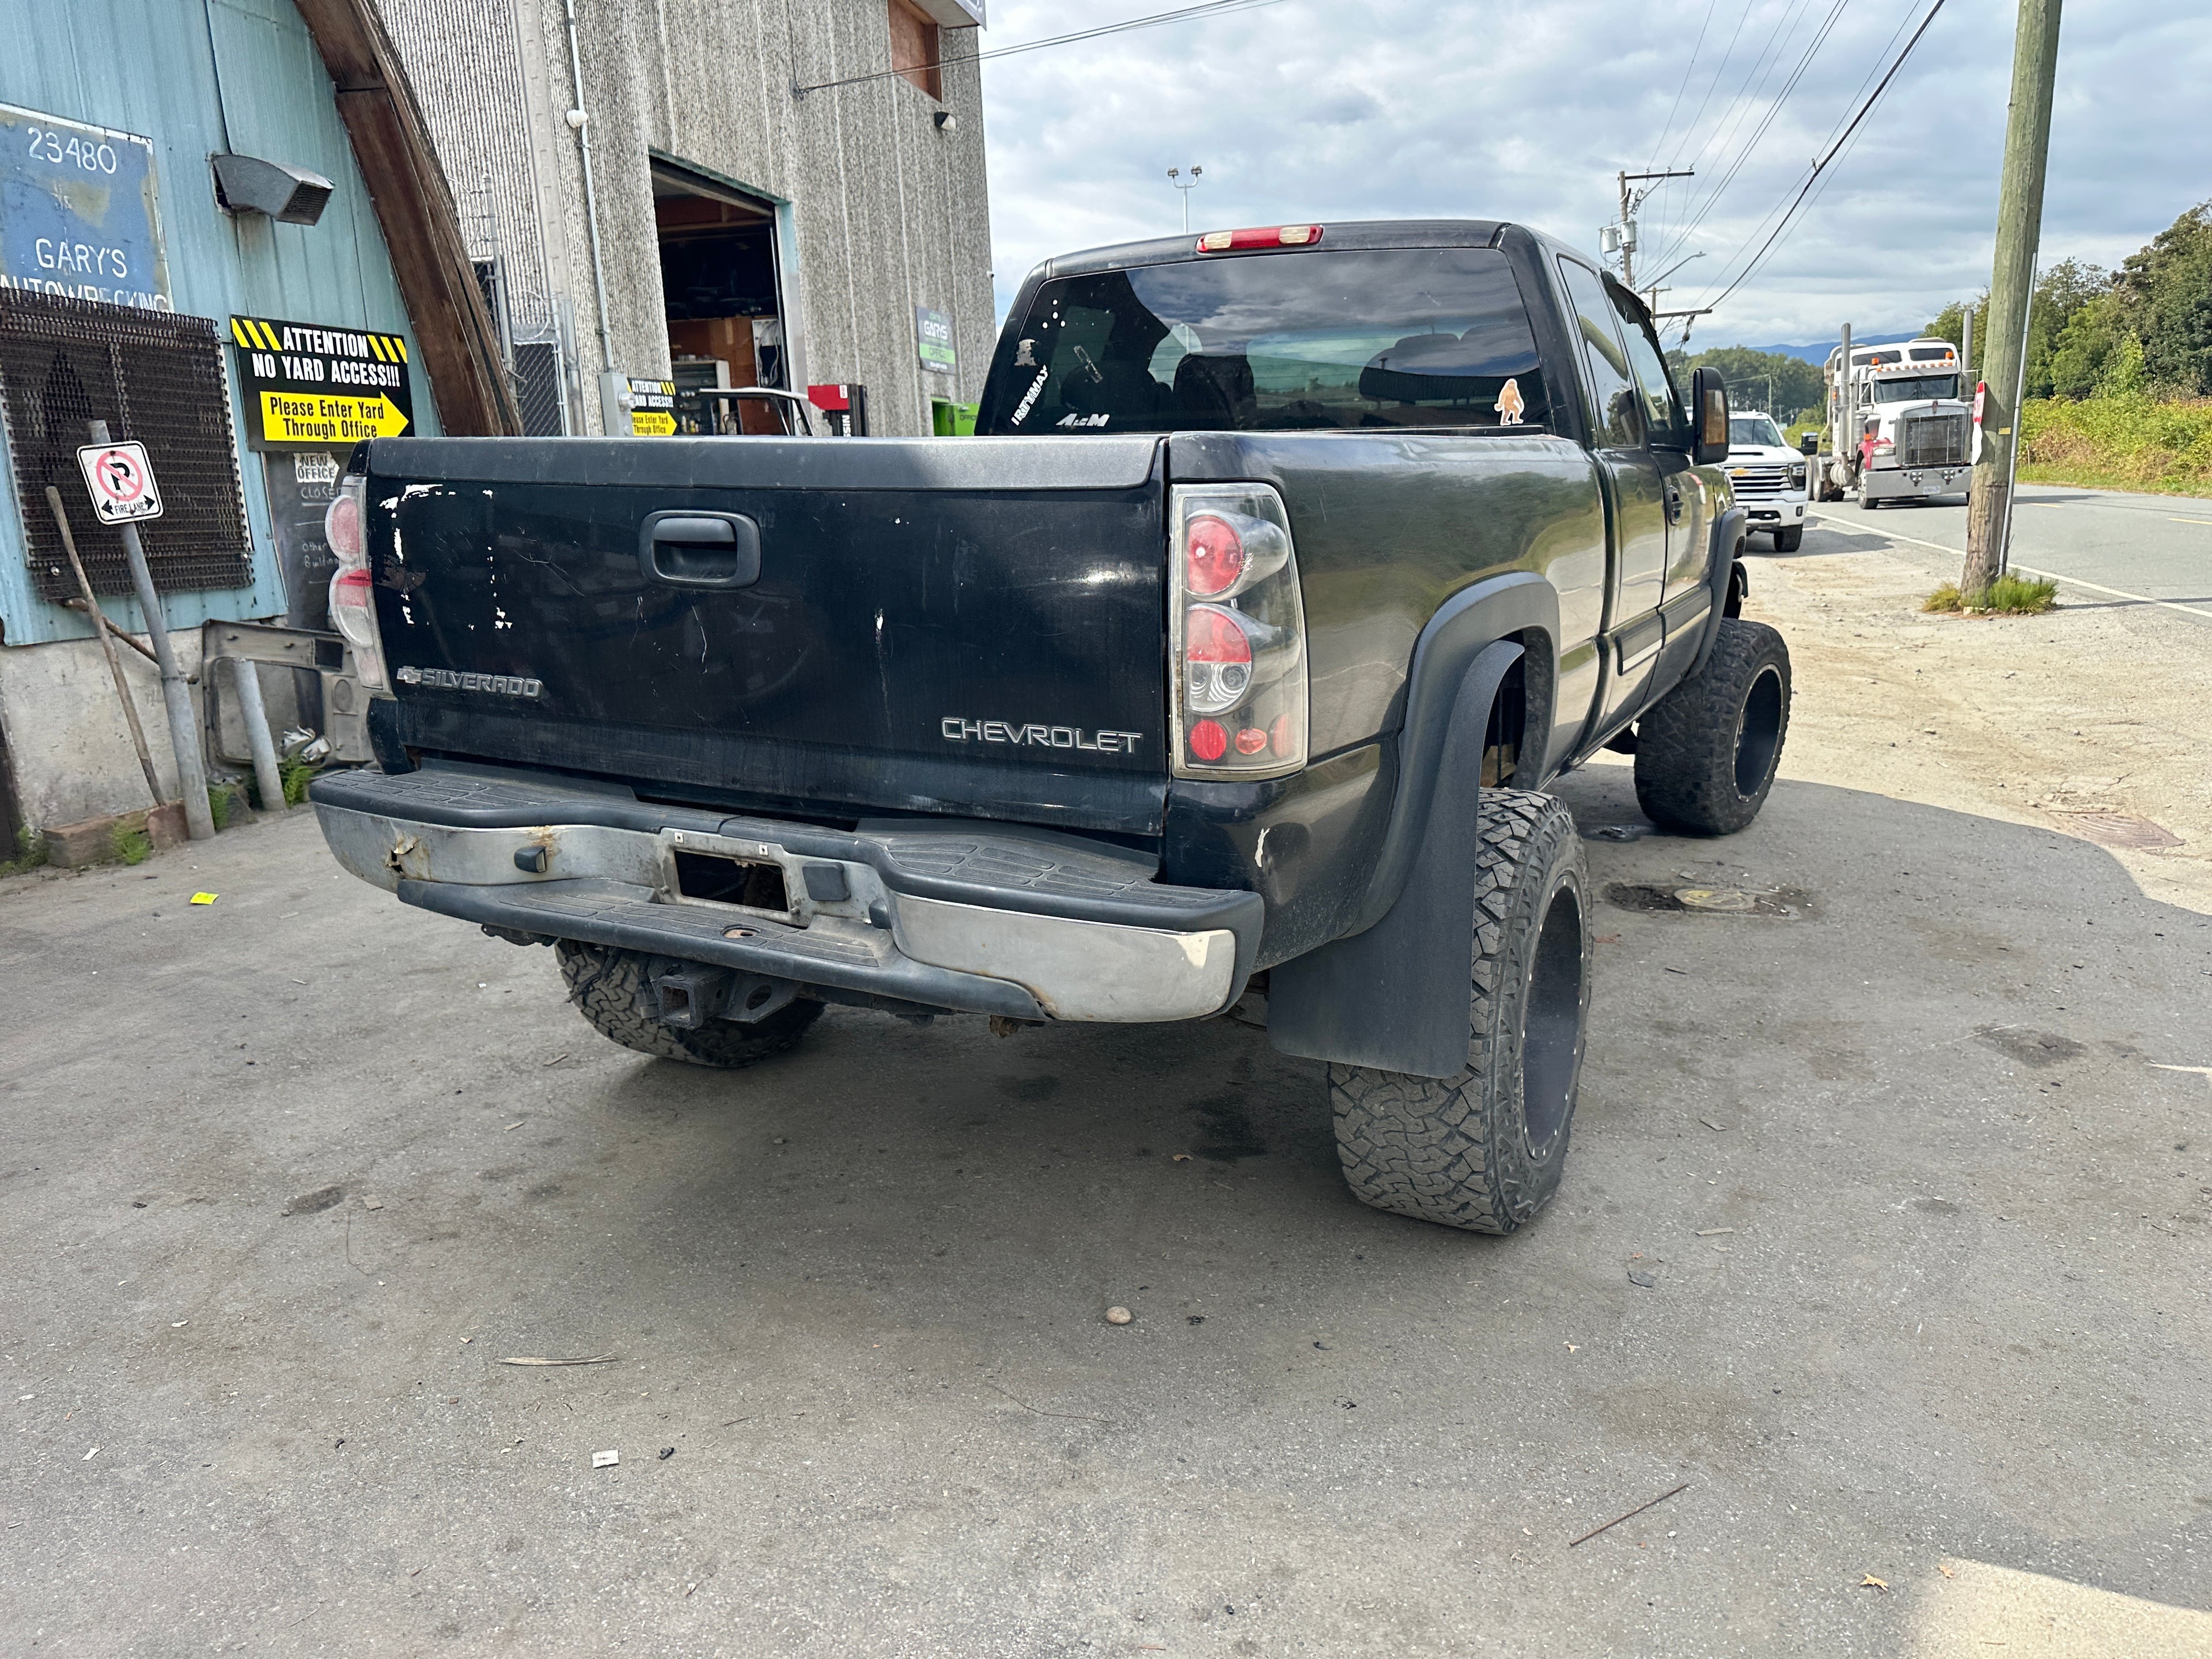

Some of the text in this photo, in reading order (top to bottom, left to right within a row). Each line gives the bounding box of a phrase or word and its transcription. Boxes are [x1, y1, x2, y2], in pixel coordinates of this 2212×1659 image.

[28, 127, 117, 174] 23480
[36, 238, 128, 278] GARY'S
[283, 327, 369, 358] ATTENTION
[252, 353, 400, 387] NO YARD ACCESS!!!
[632, 380, 662, 393] ATTENTION
[270, 396, 384, 419] Please Enter Yard
[635, 395, 673, 408] ARD ACCESS!!!
[283, 418, 377, 440] Through Office
[634, 425, 666, 435] Through Office
[645, 415, 657, 424] Enter
[658, 415, 668, 425] Yard
[842, 415, 851, 437] NIS
[300, 455, 327, 466] NEW
[298, 467, 335, 479] OFFICE
[115, 502, 146, 514] FIRE LANE
[421, 668, 543, 698] SILVERADO
[941, 717, 1143, 753] CHEVROLET
